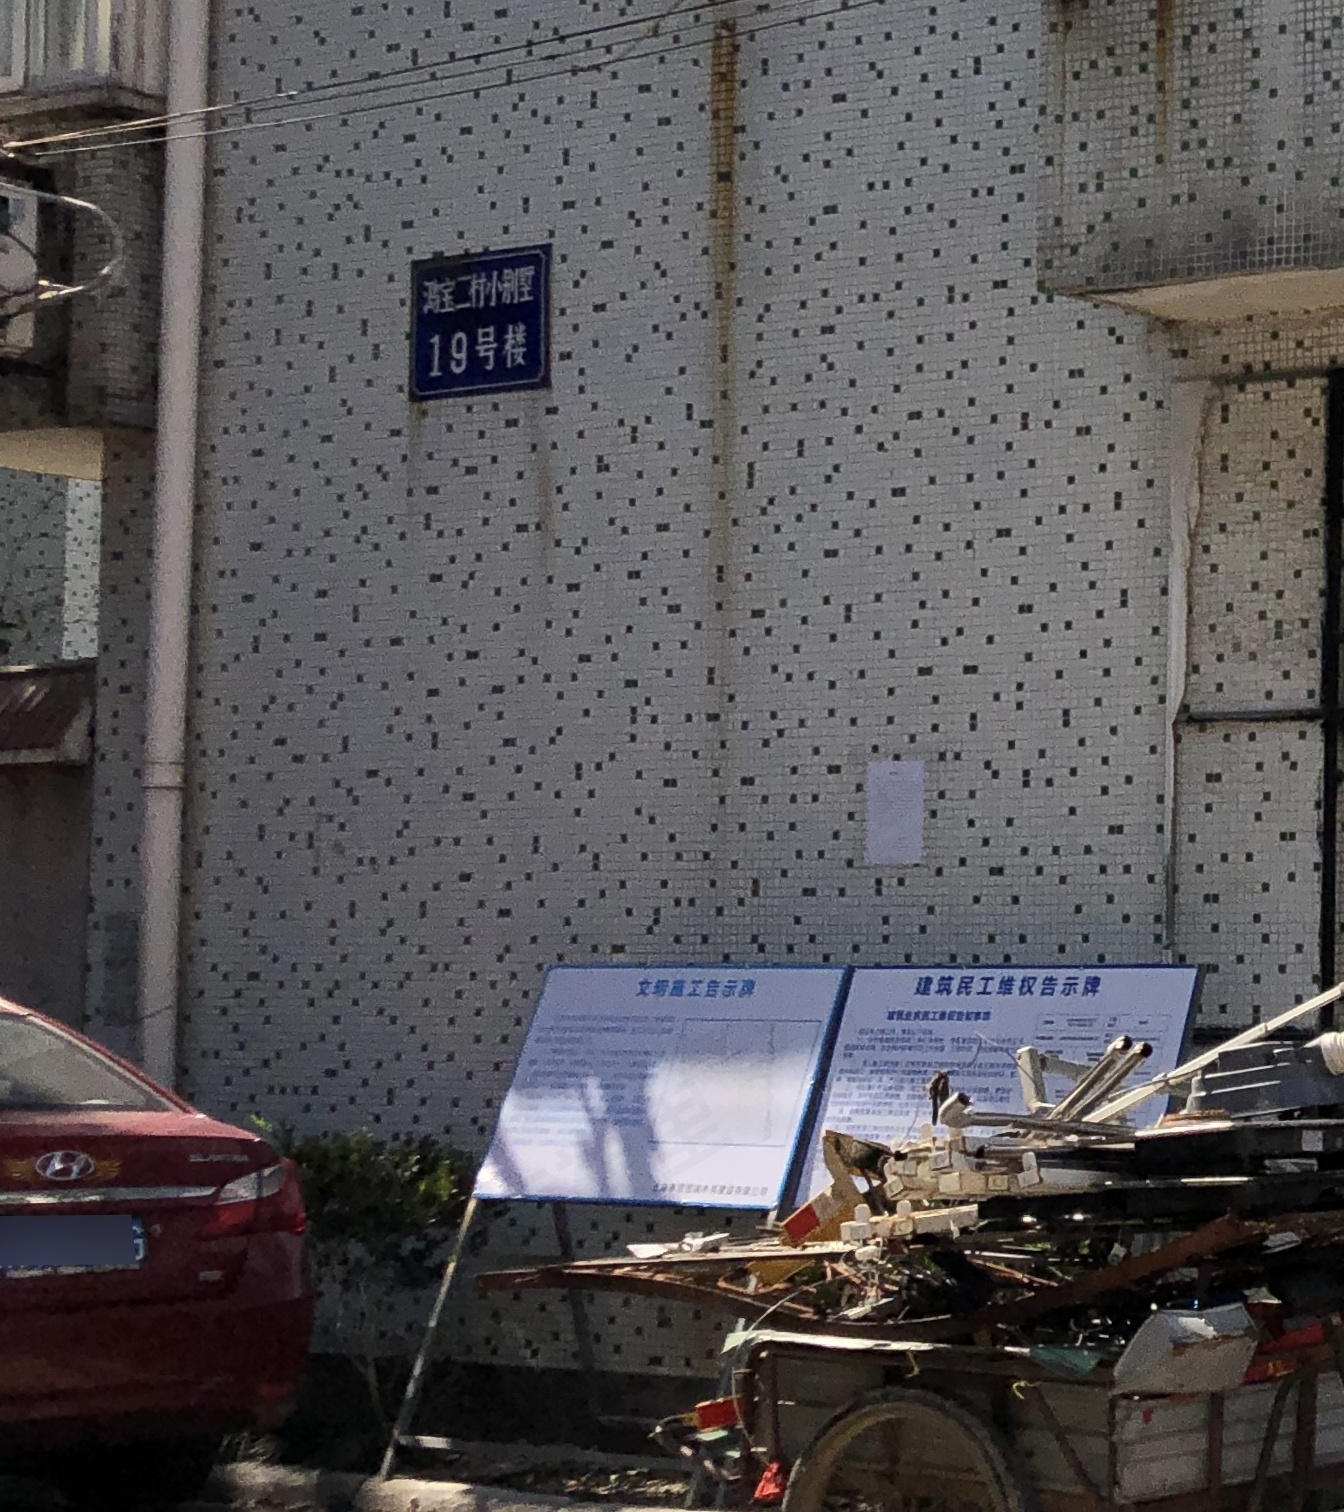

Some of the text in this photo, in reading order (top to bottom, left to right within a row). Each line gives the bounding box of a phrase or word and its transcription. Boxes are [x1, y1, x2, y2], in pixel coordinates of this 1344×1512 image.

[430, 322, 527, 376] 19号楼
[914, 976, 1101, 996] 建筑民工维权告示牌
